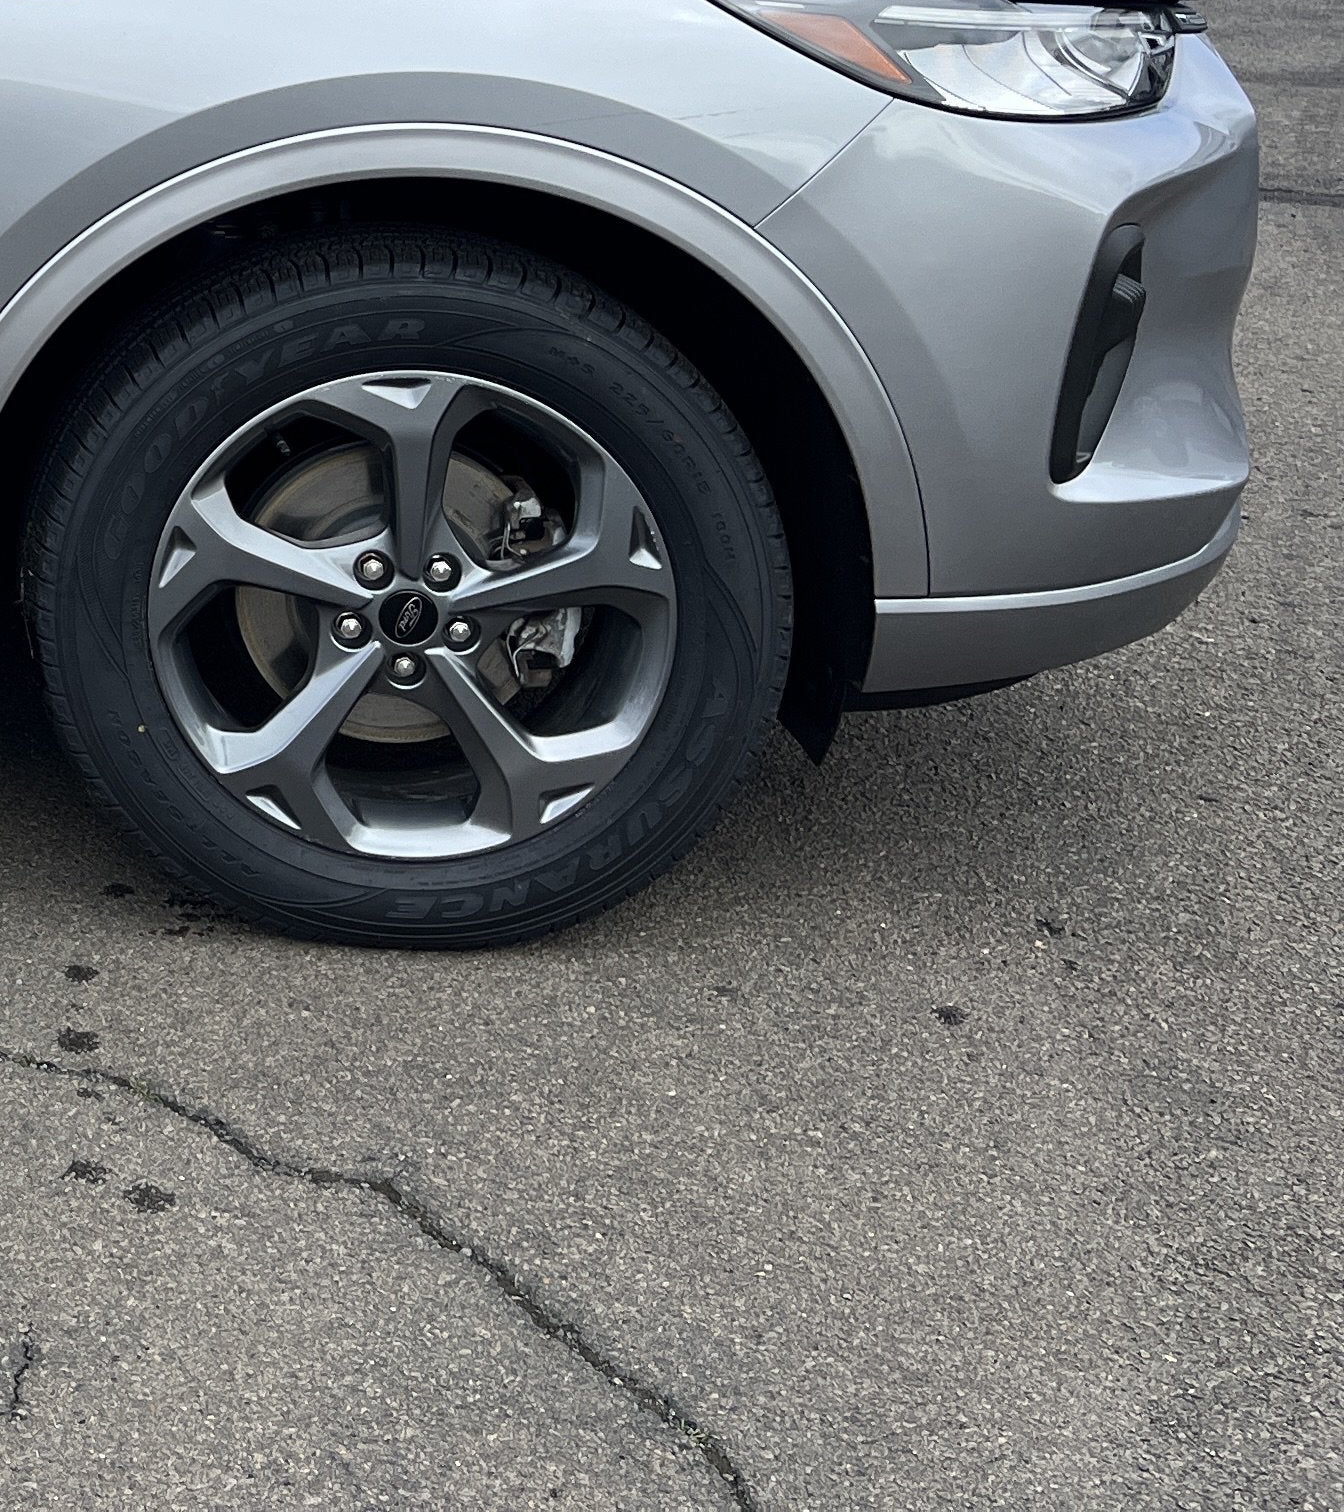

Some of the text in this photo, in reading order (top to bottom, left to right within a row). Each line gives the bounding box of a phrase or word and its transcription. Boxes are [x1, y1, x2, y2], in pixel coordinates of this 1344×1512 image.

[105, 317, 426, 561] GOODYEAR
[398, 603, 419, 632] Ford
[386, 677, 737, 919] ASSURANCE
